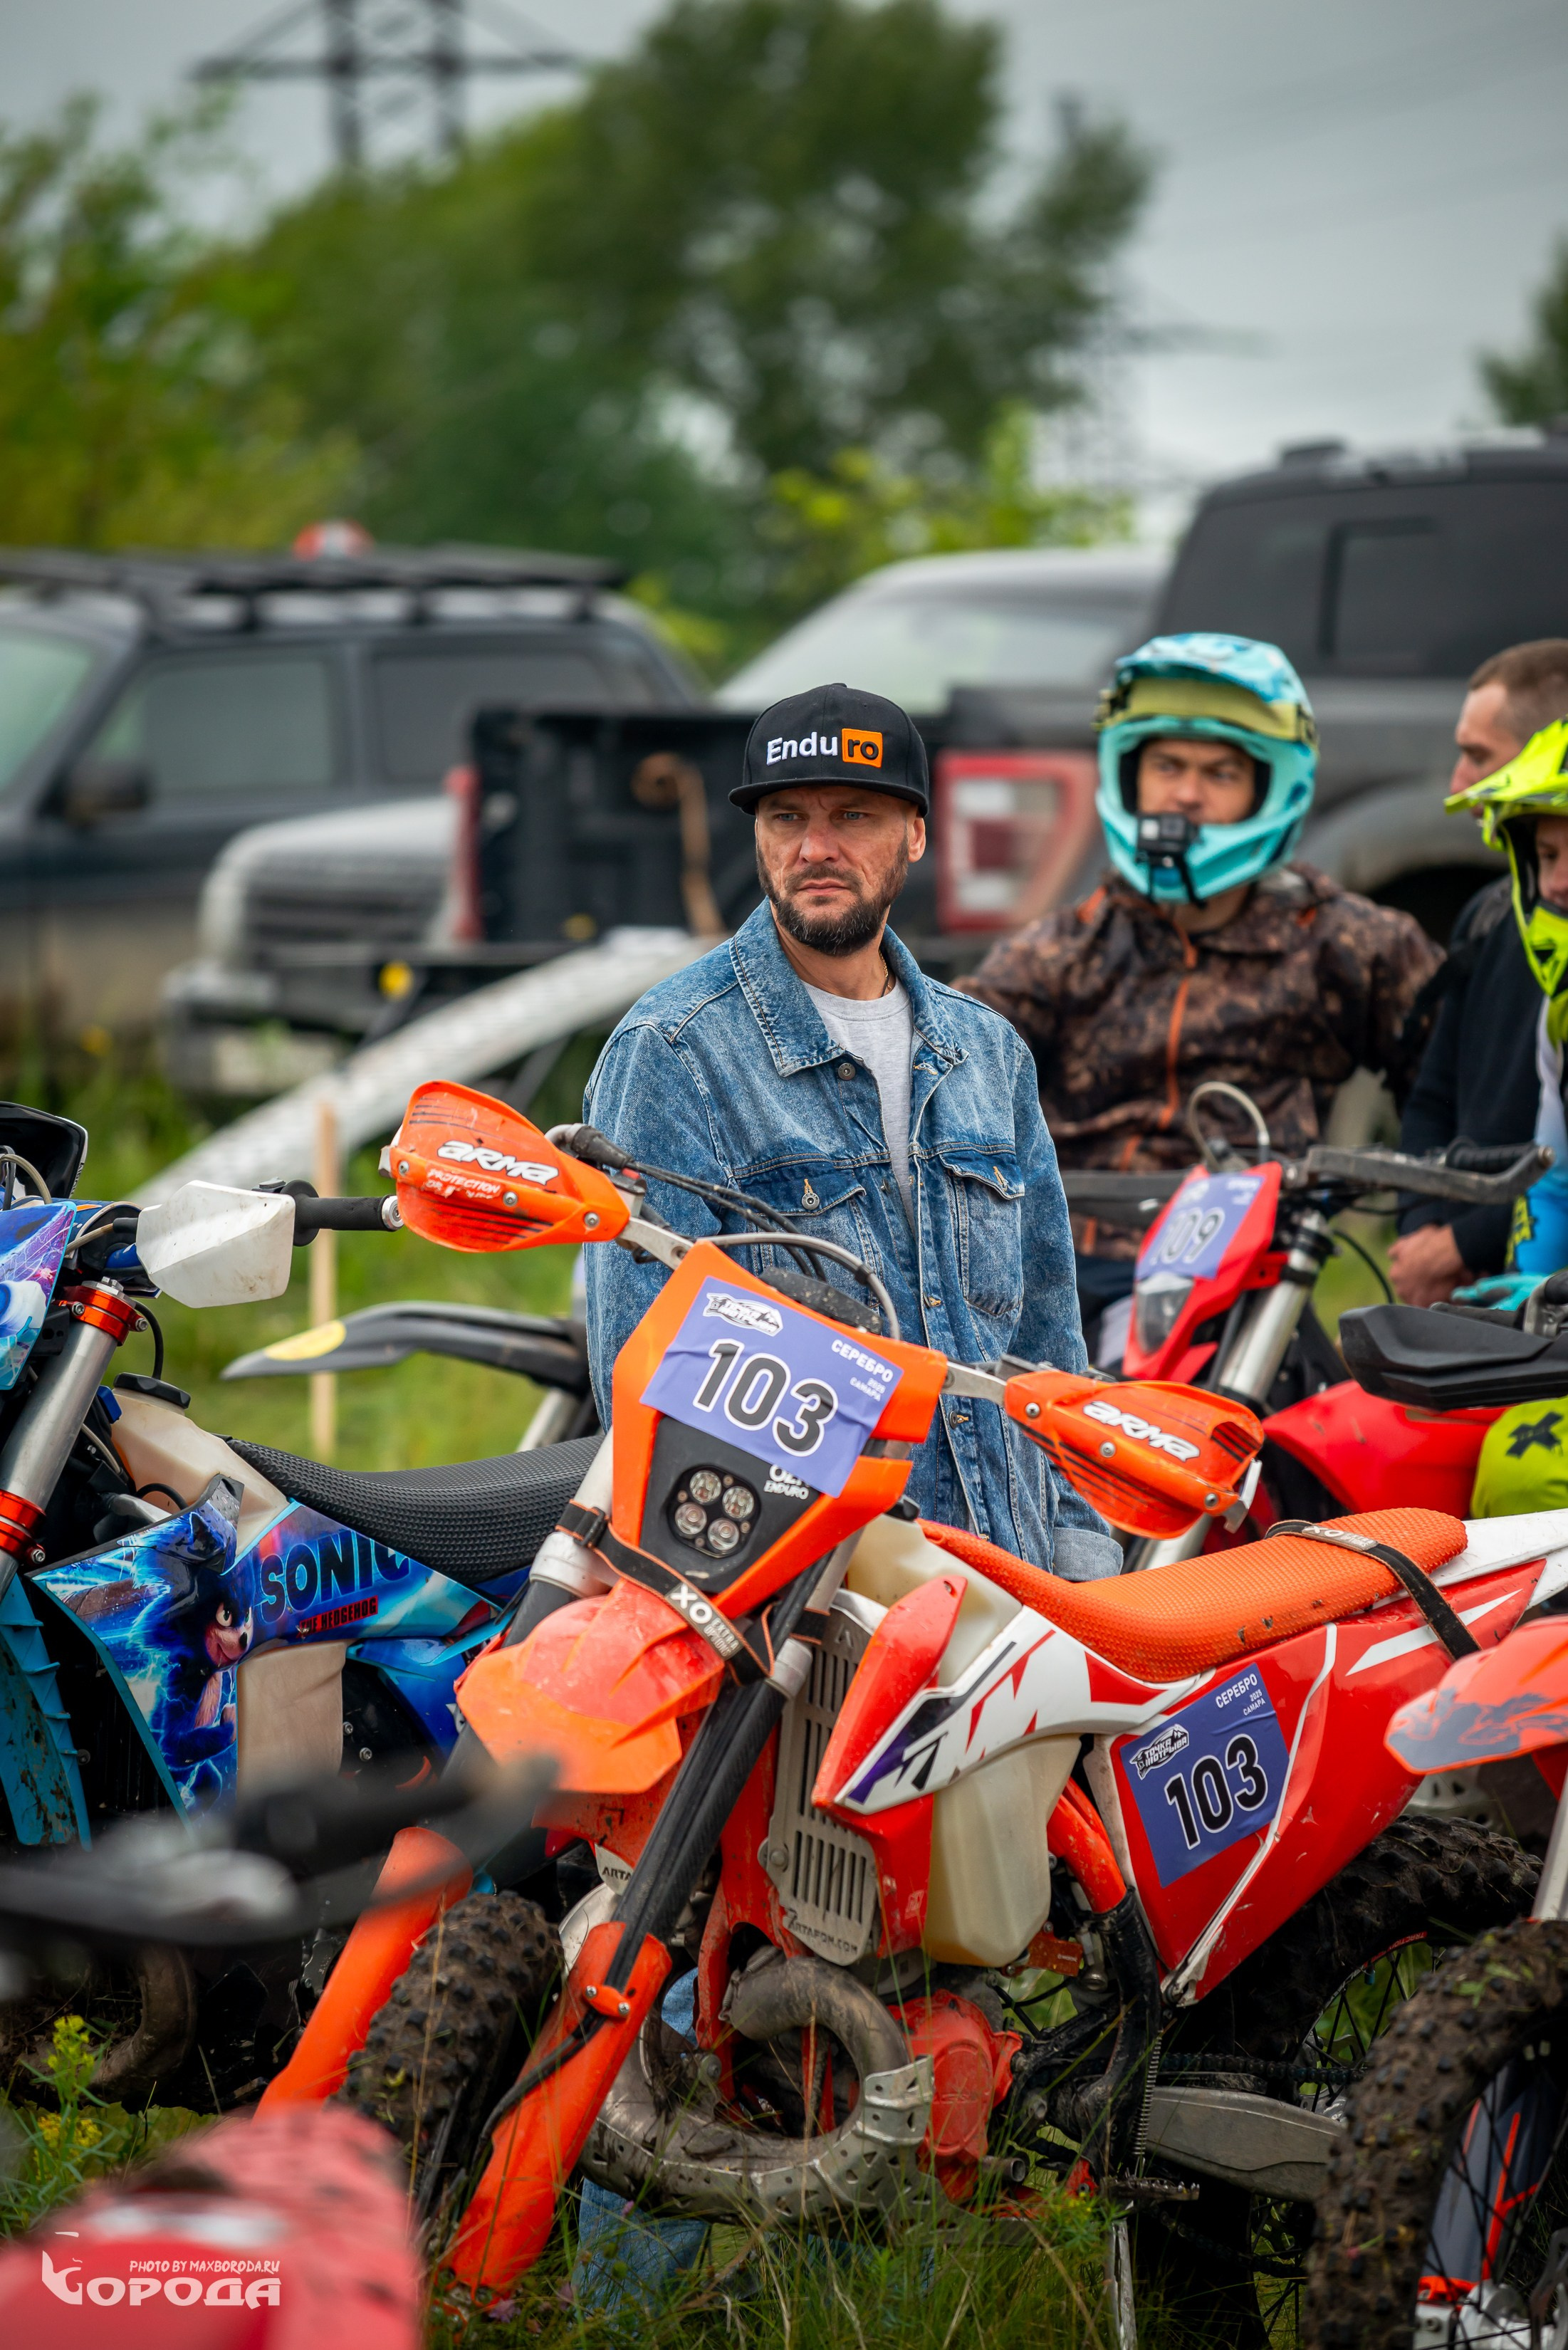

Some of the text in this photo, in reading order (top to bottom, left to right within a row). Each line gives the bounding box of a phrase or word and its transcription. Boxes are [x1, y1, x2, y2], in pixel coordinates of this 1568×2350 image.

[427, 1167, 501, 1194] PROTECTION
[831, 1339, 894, 1383] СЕРЕБРО
[692, 1338, 840, 1457] 103
[321, 1597, 377, 1629] HEDGEHOG
[1215, 1673, 1258, 1709] СЕРЕБРО
[1243, 1698, 1266, 1716] САМАРА
[1144, 1738, 1172, 1759] ТОЧКА
[1164, 1733, 1269, 1850] 103
